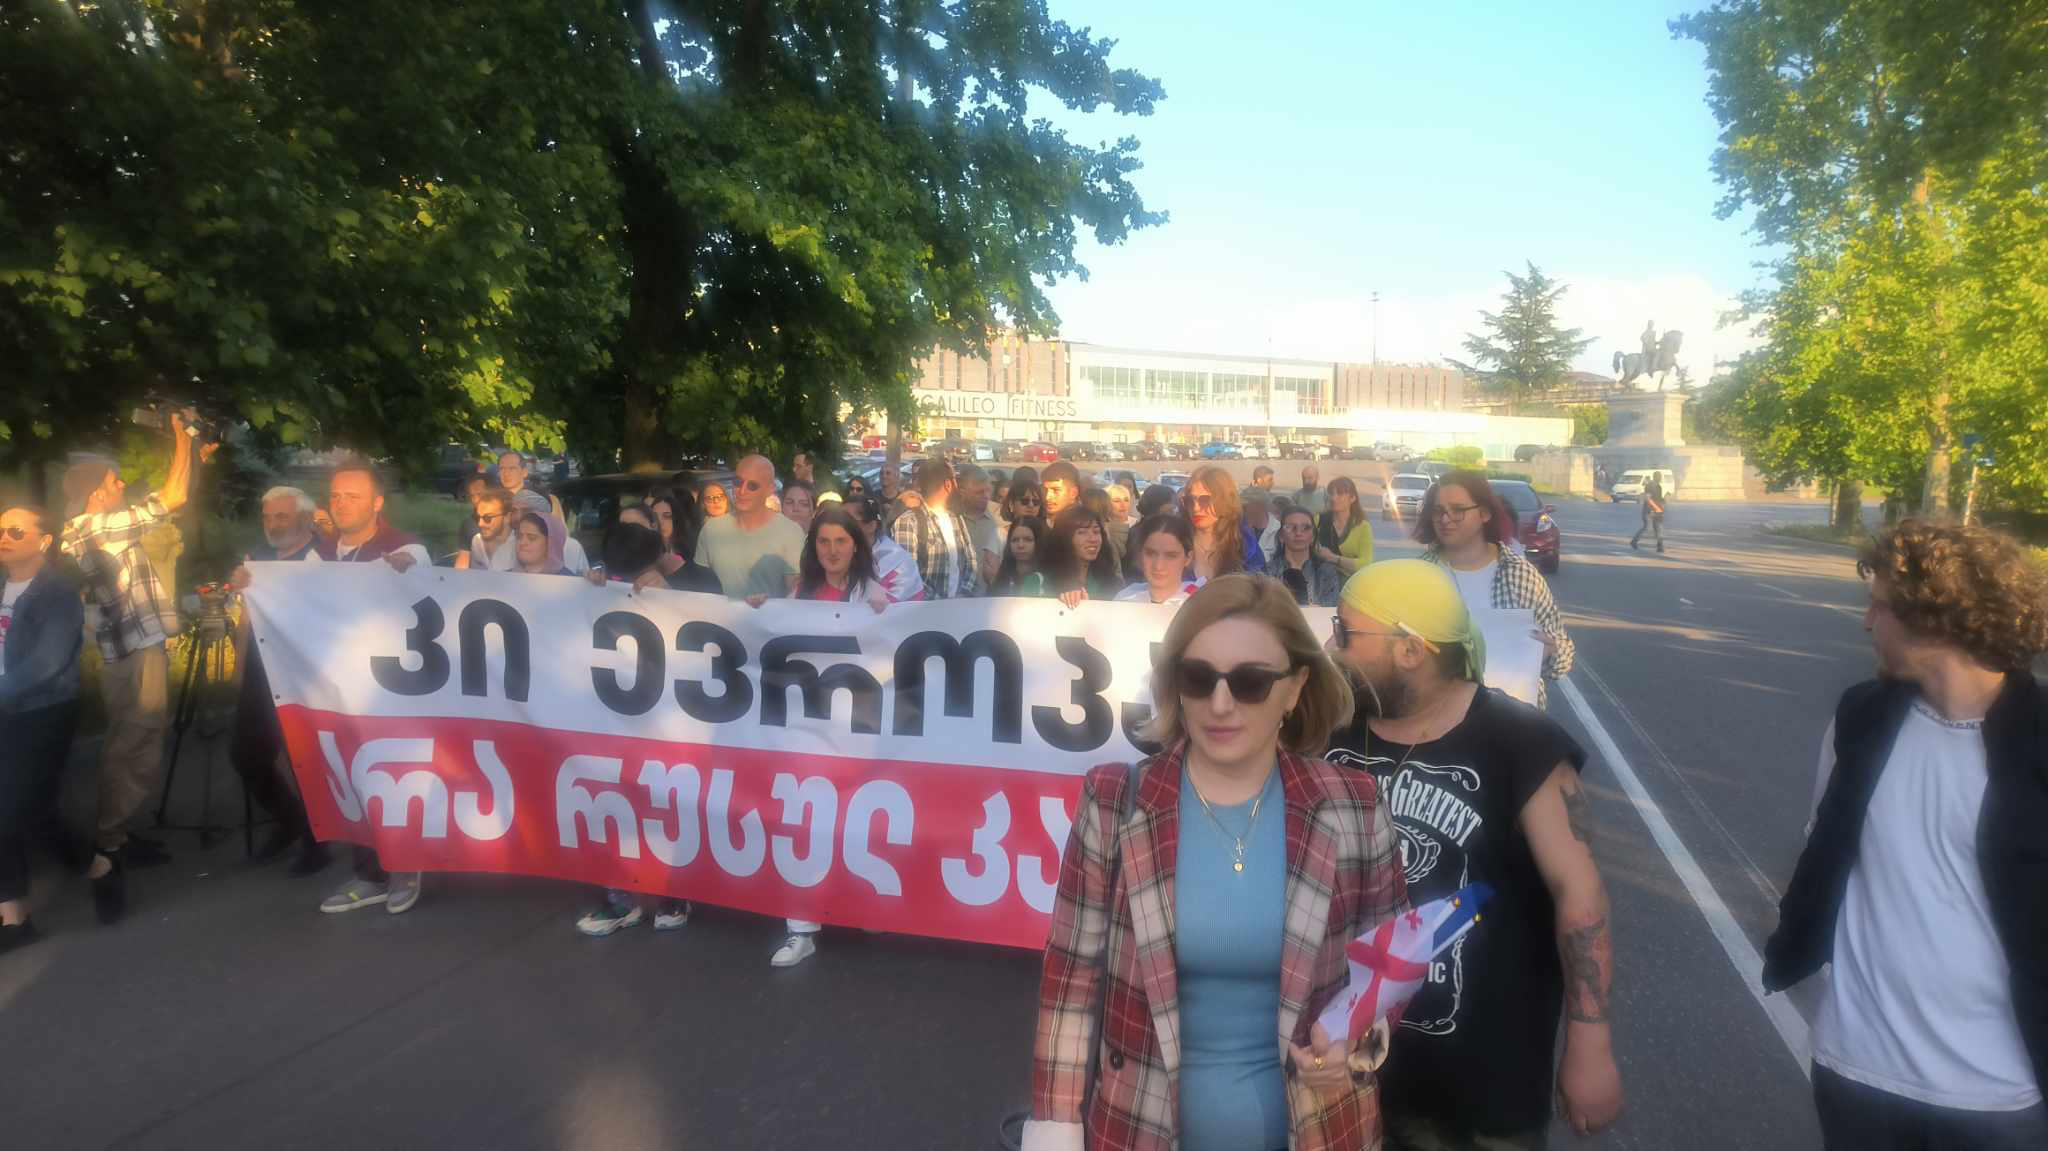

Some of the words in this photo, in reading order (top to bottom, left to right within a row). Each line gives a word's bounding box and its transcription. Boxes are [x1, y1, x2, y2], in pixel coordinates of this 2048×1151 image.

[370, 595, 531, 702] კი
[317, 730, 515, 840] არა
[555, 754, 914, 896] რუსულ
[941, 791, 1072, 914] კა
[1428, 961, 1446, 984] IC
